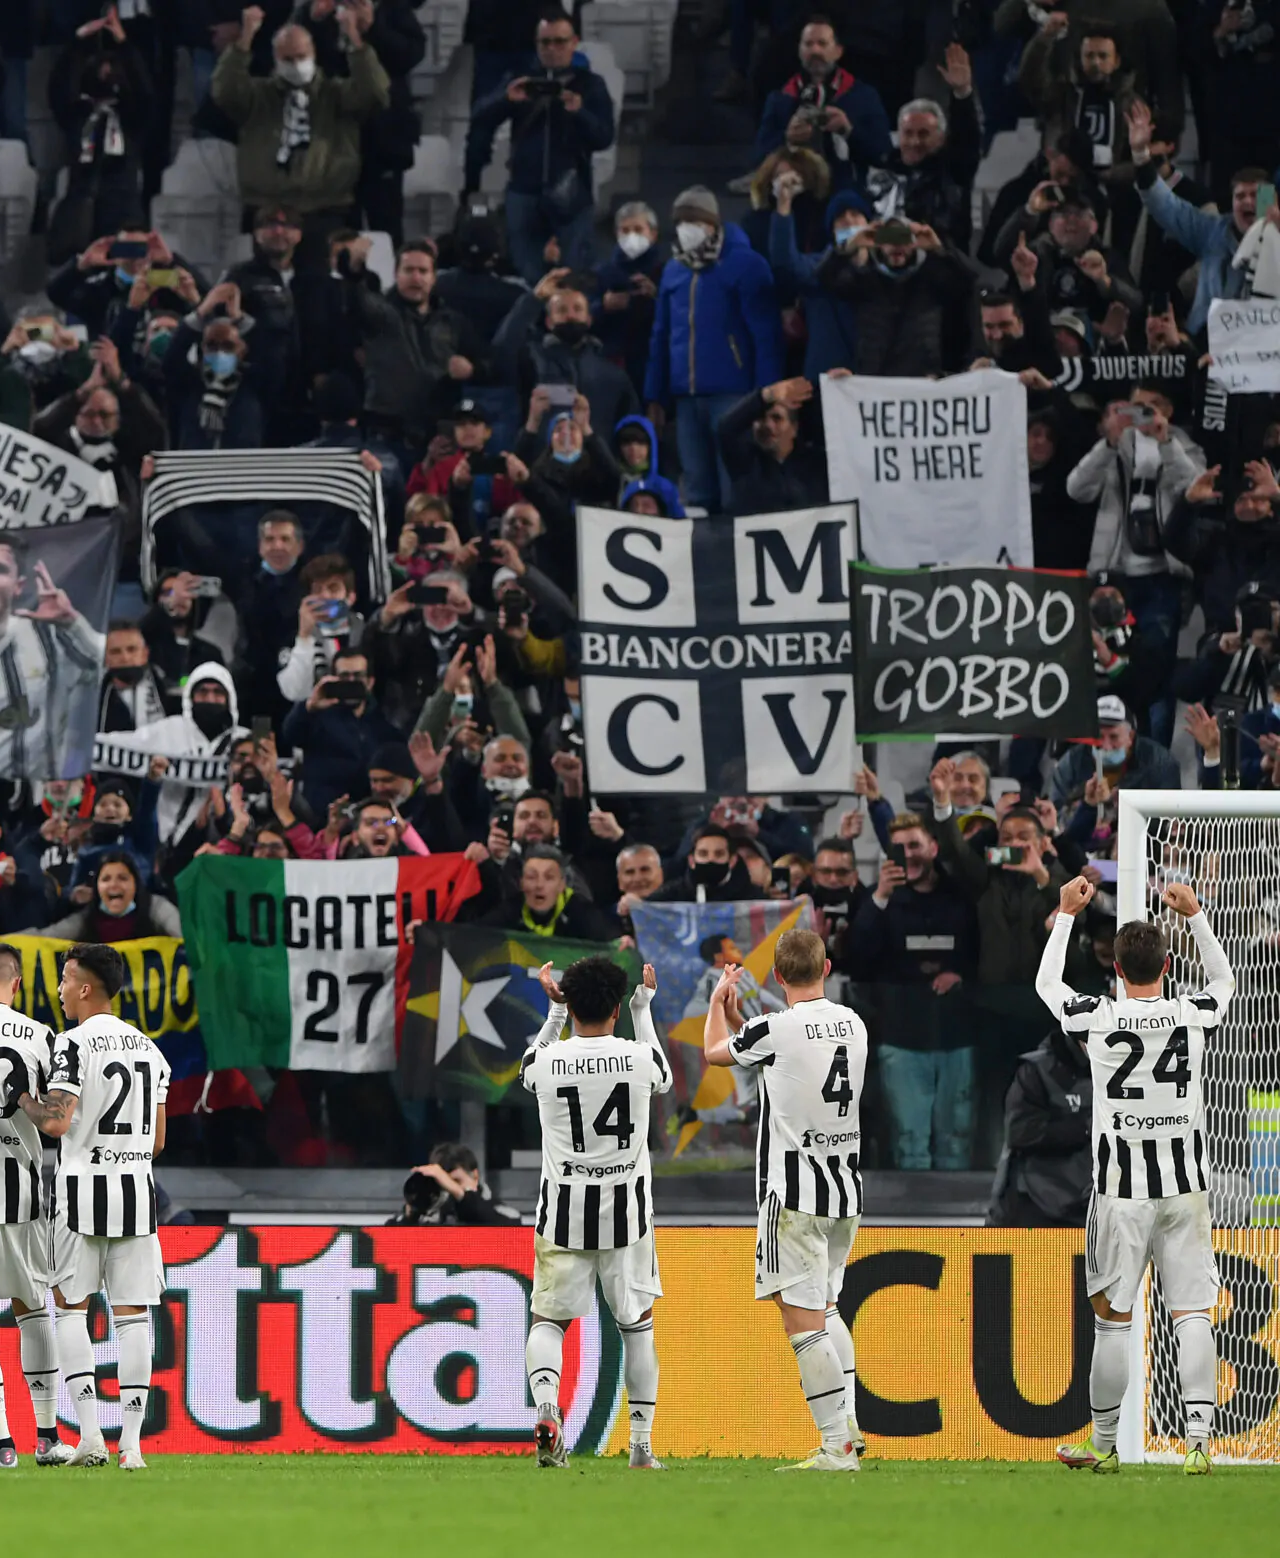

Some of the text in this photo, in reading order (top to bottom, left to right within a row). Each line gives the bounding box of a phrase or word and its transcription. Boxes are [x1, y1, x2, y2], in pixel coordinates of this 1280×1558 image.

[1091, 354, 1186, 380] JUVENTUS
[859, 396, 990, 437] HERISAU
[874, 443, 983, 482] IS HERE
[602, 521, 849, 611] S M
[861, 579, 1075, 646] TROPPO
[580, 631, 851, 670] BIANCONERA
[873, 654, 1069, 723] GOBBO
[607, 691, 847, 775] C V
[304, 970, 385, 1044] 27
[805, 1020, 854, 1040] DE LIGT
[552, 1055, 634, 1076] McKENNIE
[821, 1045, 853, 1118] 4
[1104, 1025, 1192, 1100] 24
[98, 1061, 151, 1135] 21
[557, 1082, 635, 1153] 14
[1125, 1114, 1189, 1129] Cygames
[104, 1149, 152, 1164] Cygame
